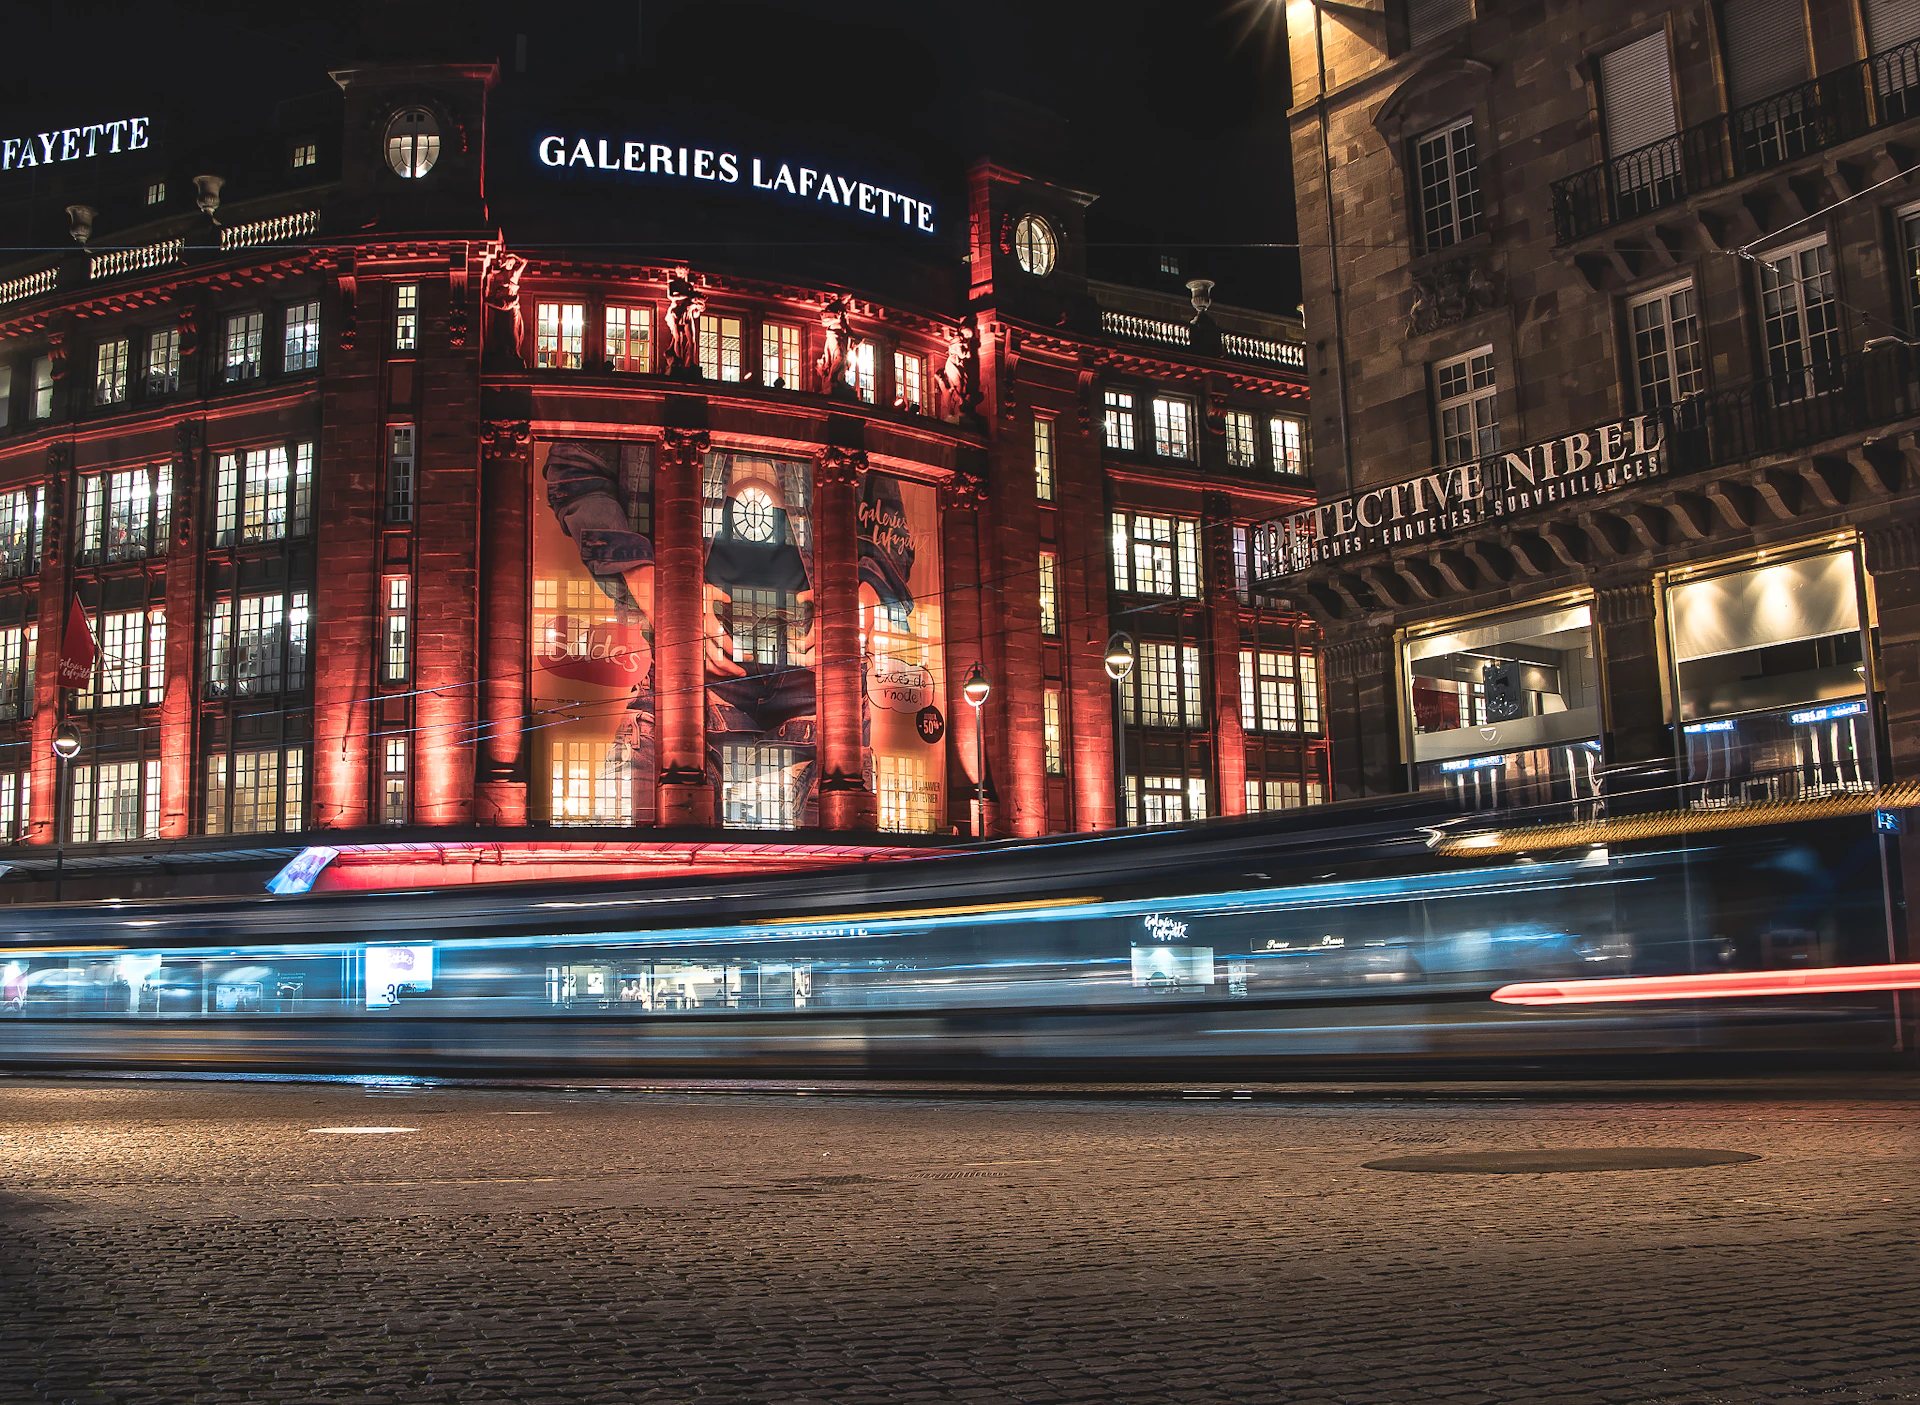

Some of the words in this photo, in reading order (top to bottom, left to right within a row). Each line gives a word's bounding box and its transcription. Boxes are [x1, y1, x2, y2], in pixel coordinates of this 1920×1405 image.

[2, 117, 149, 170] FAYETTE
[538, 135, 739, 184] GALERIES
[752, 158, 935, 233] LAFAYETTE
[1260, 462, 1485, 556] DETECTIVE
[1501, 414, 1662, 492] NIBEL
[1383, 508, 1471, 545] ENQUETES
[1493, 456, 1658, 517] SURVEILLANCES
[548, 630, 642, 673] Soldes
